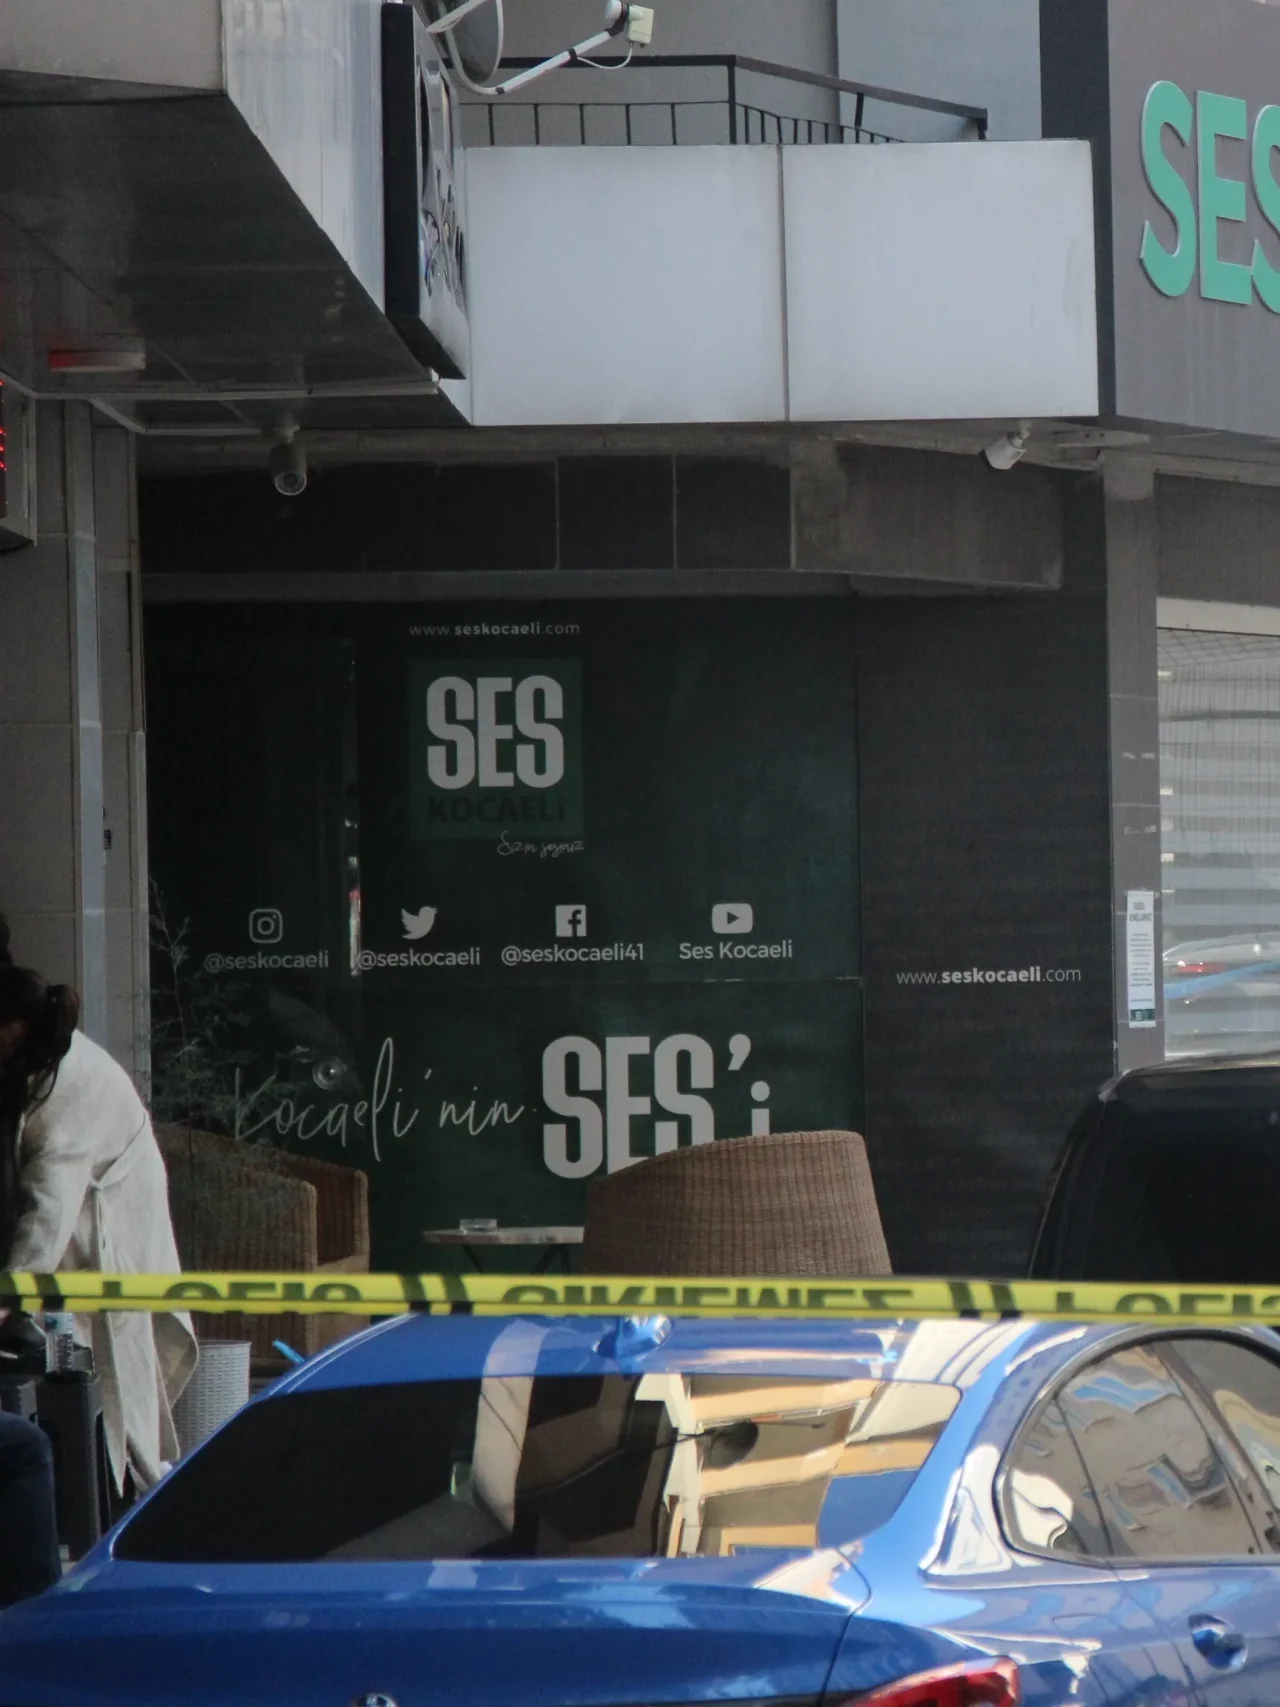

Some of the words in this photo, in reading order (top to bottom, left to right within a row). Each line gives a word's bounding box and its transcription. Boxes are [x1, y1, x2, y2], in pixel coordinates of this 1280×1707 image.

[408, 621, 580, 636] www.seskocaeli.com
[425, 675, 565, 790] SES
[357, 948, 480, 970] @seskocaeli
[501, 944, 644, 966] @seskocaeli41
[679, 943, 713, 959] Ses
[719, 940, 793, 958] Kocaeli
[204, 951, 329, 973] @seskocaeli
[896, 966, 1081, 984] www.seskocaeli.com
